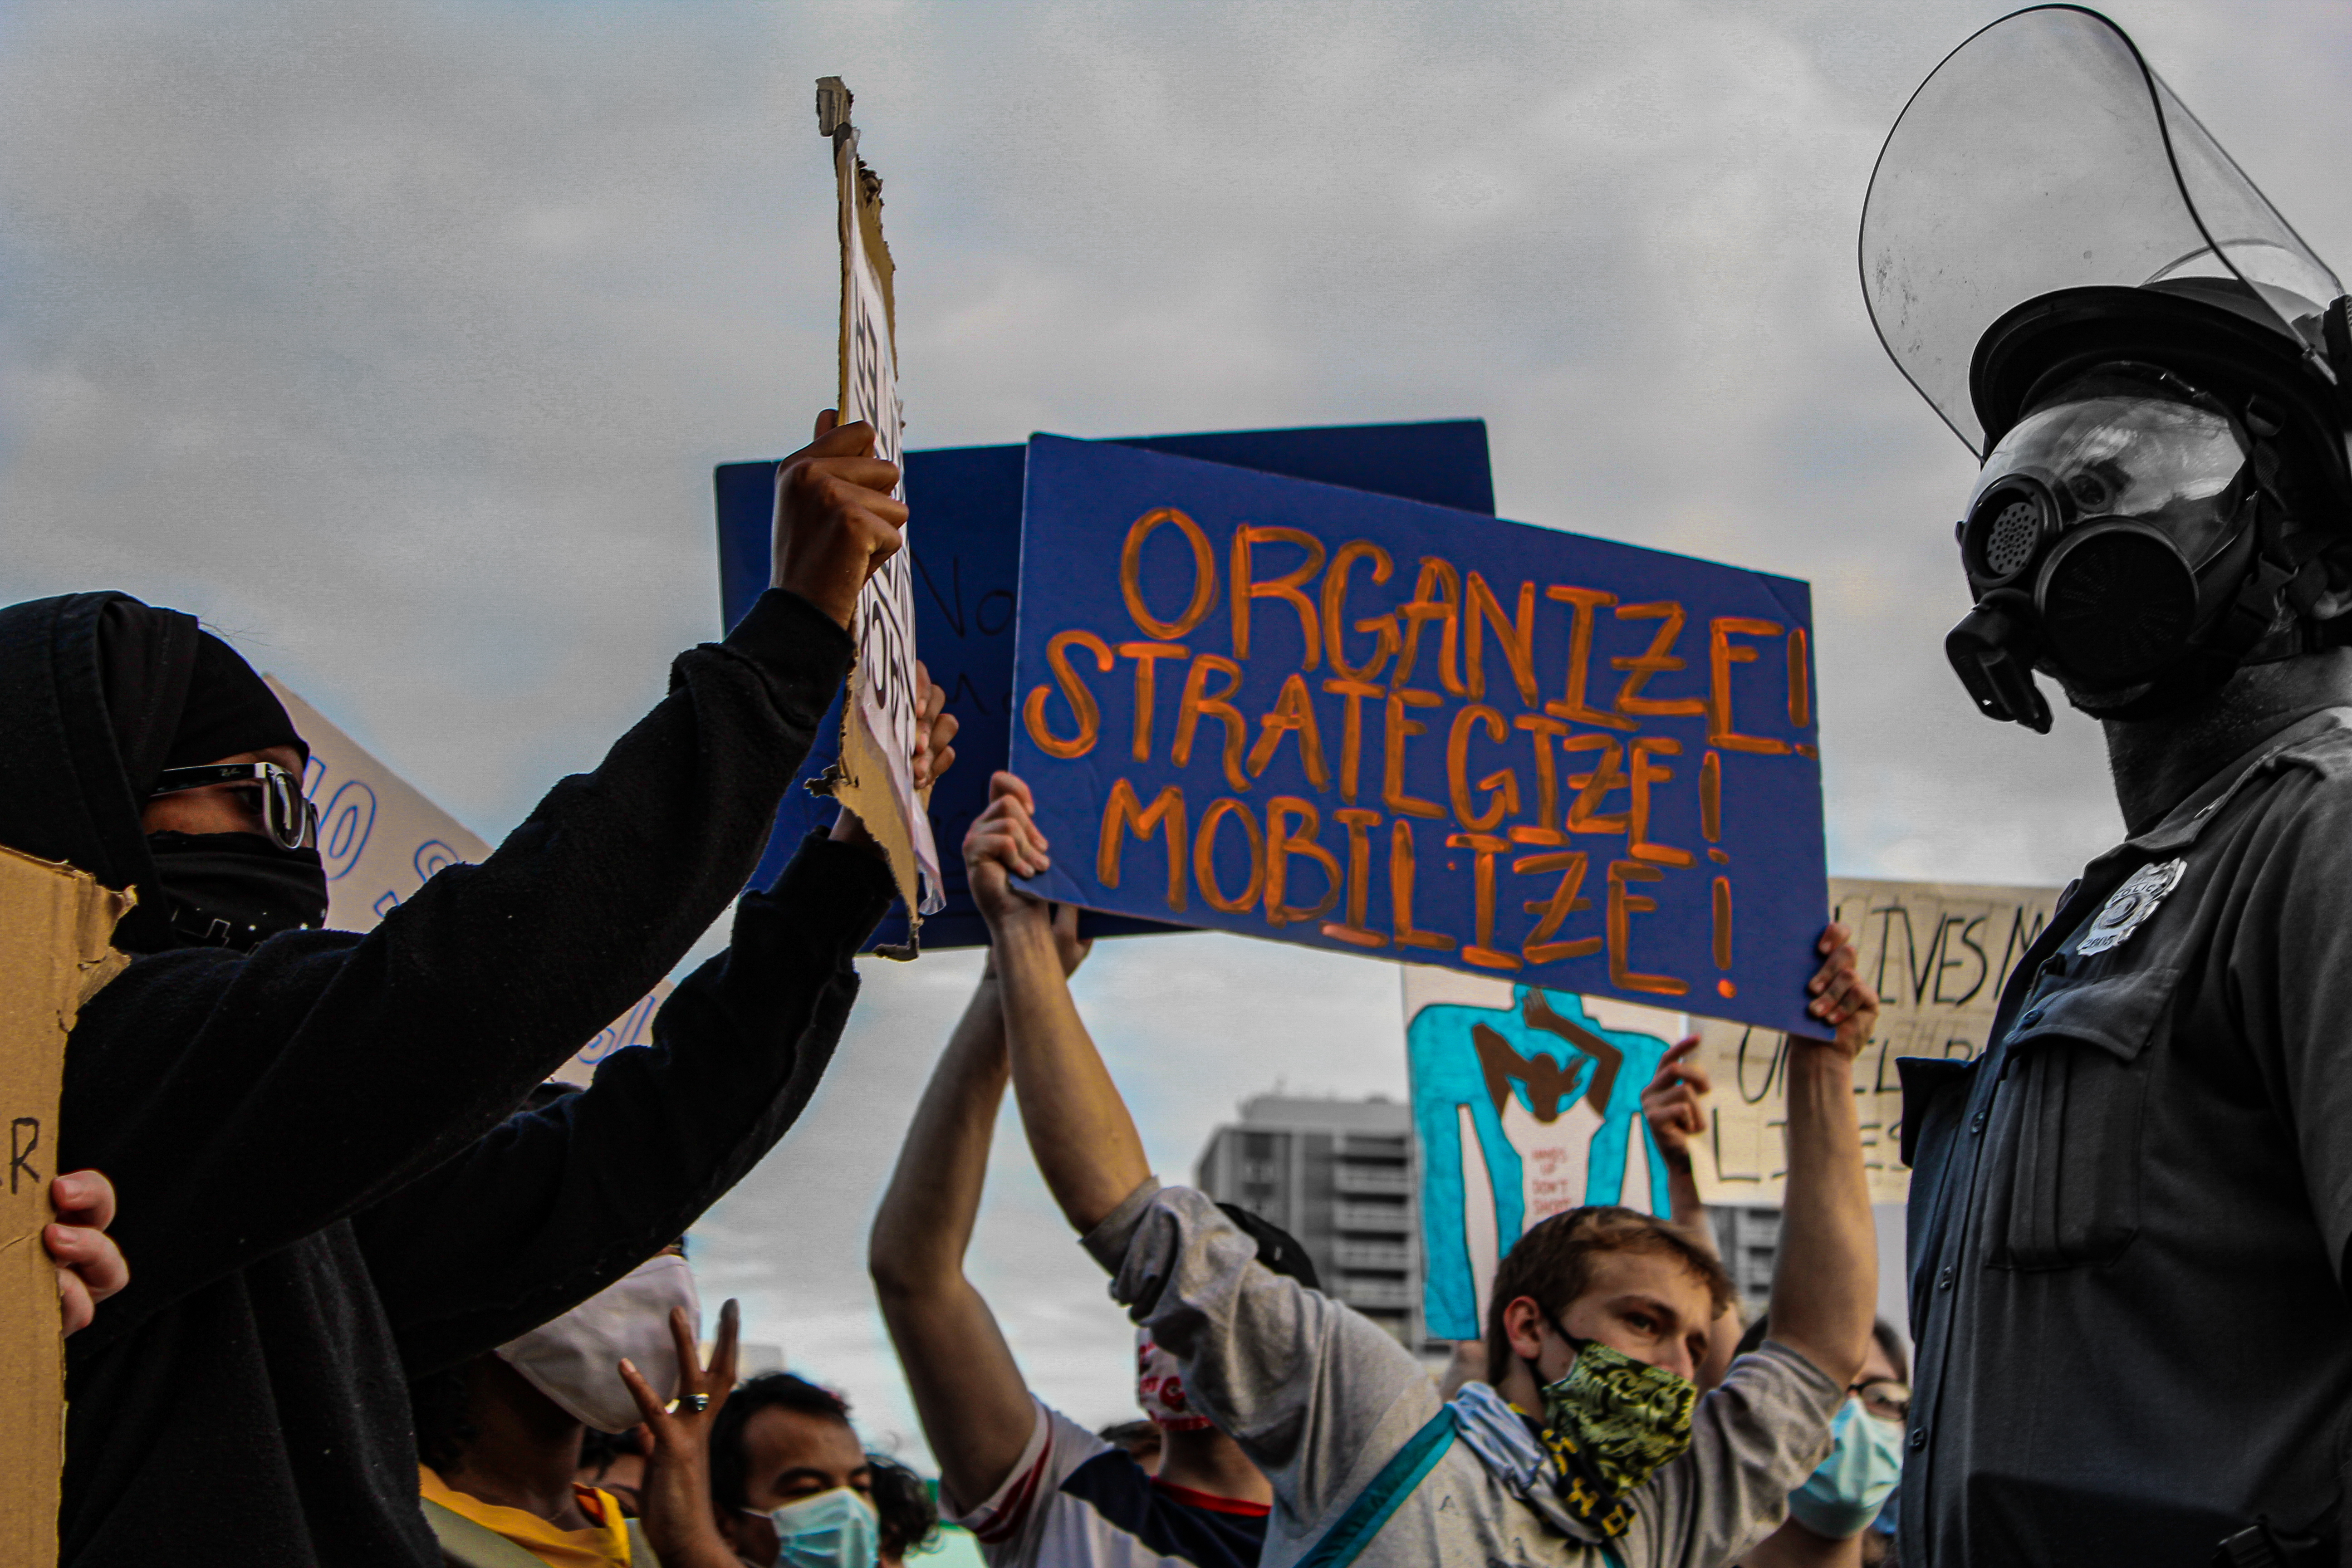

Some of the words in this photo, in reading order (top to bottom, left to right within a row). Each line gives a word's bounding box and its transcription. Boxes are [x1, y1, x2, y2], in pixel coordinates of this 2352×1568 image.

[1023, 629, 1730, 869] STRATEGIZE!
[1119, 507, 1817, 760] ORGANIZE!
[1097, 777, 1737, 997] MOBILIZE!
